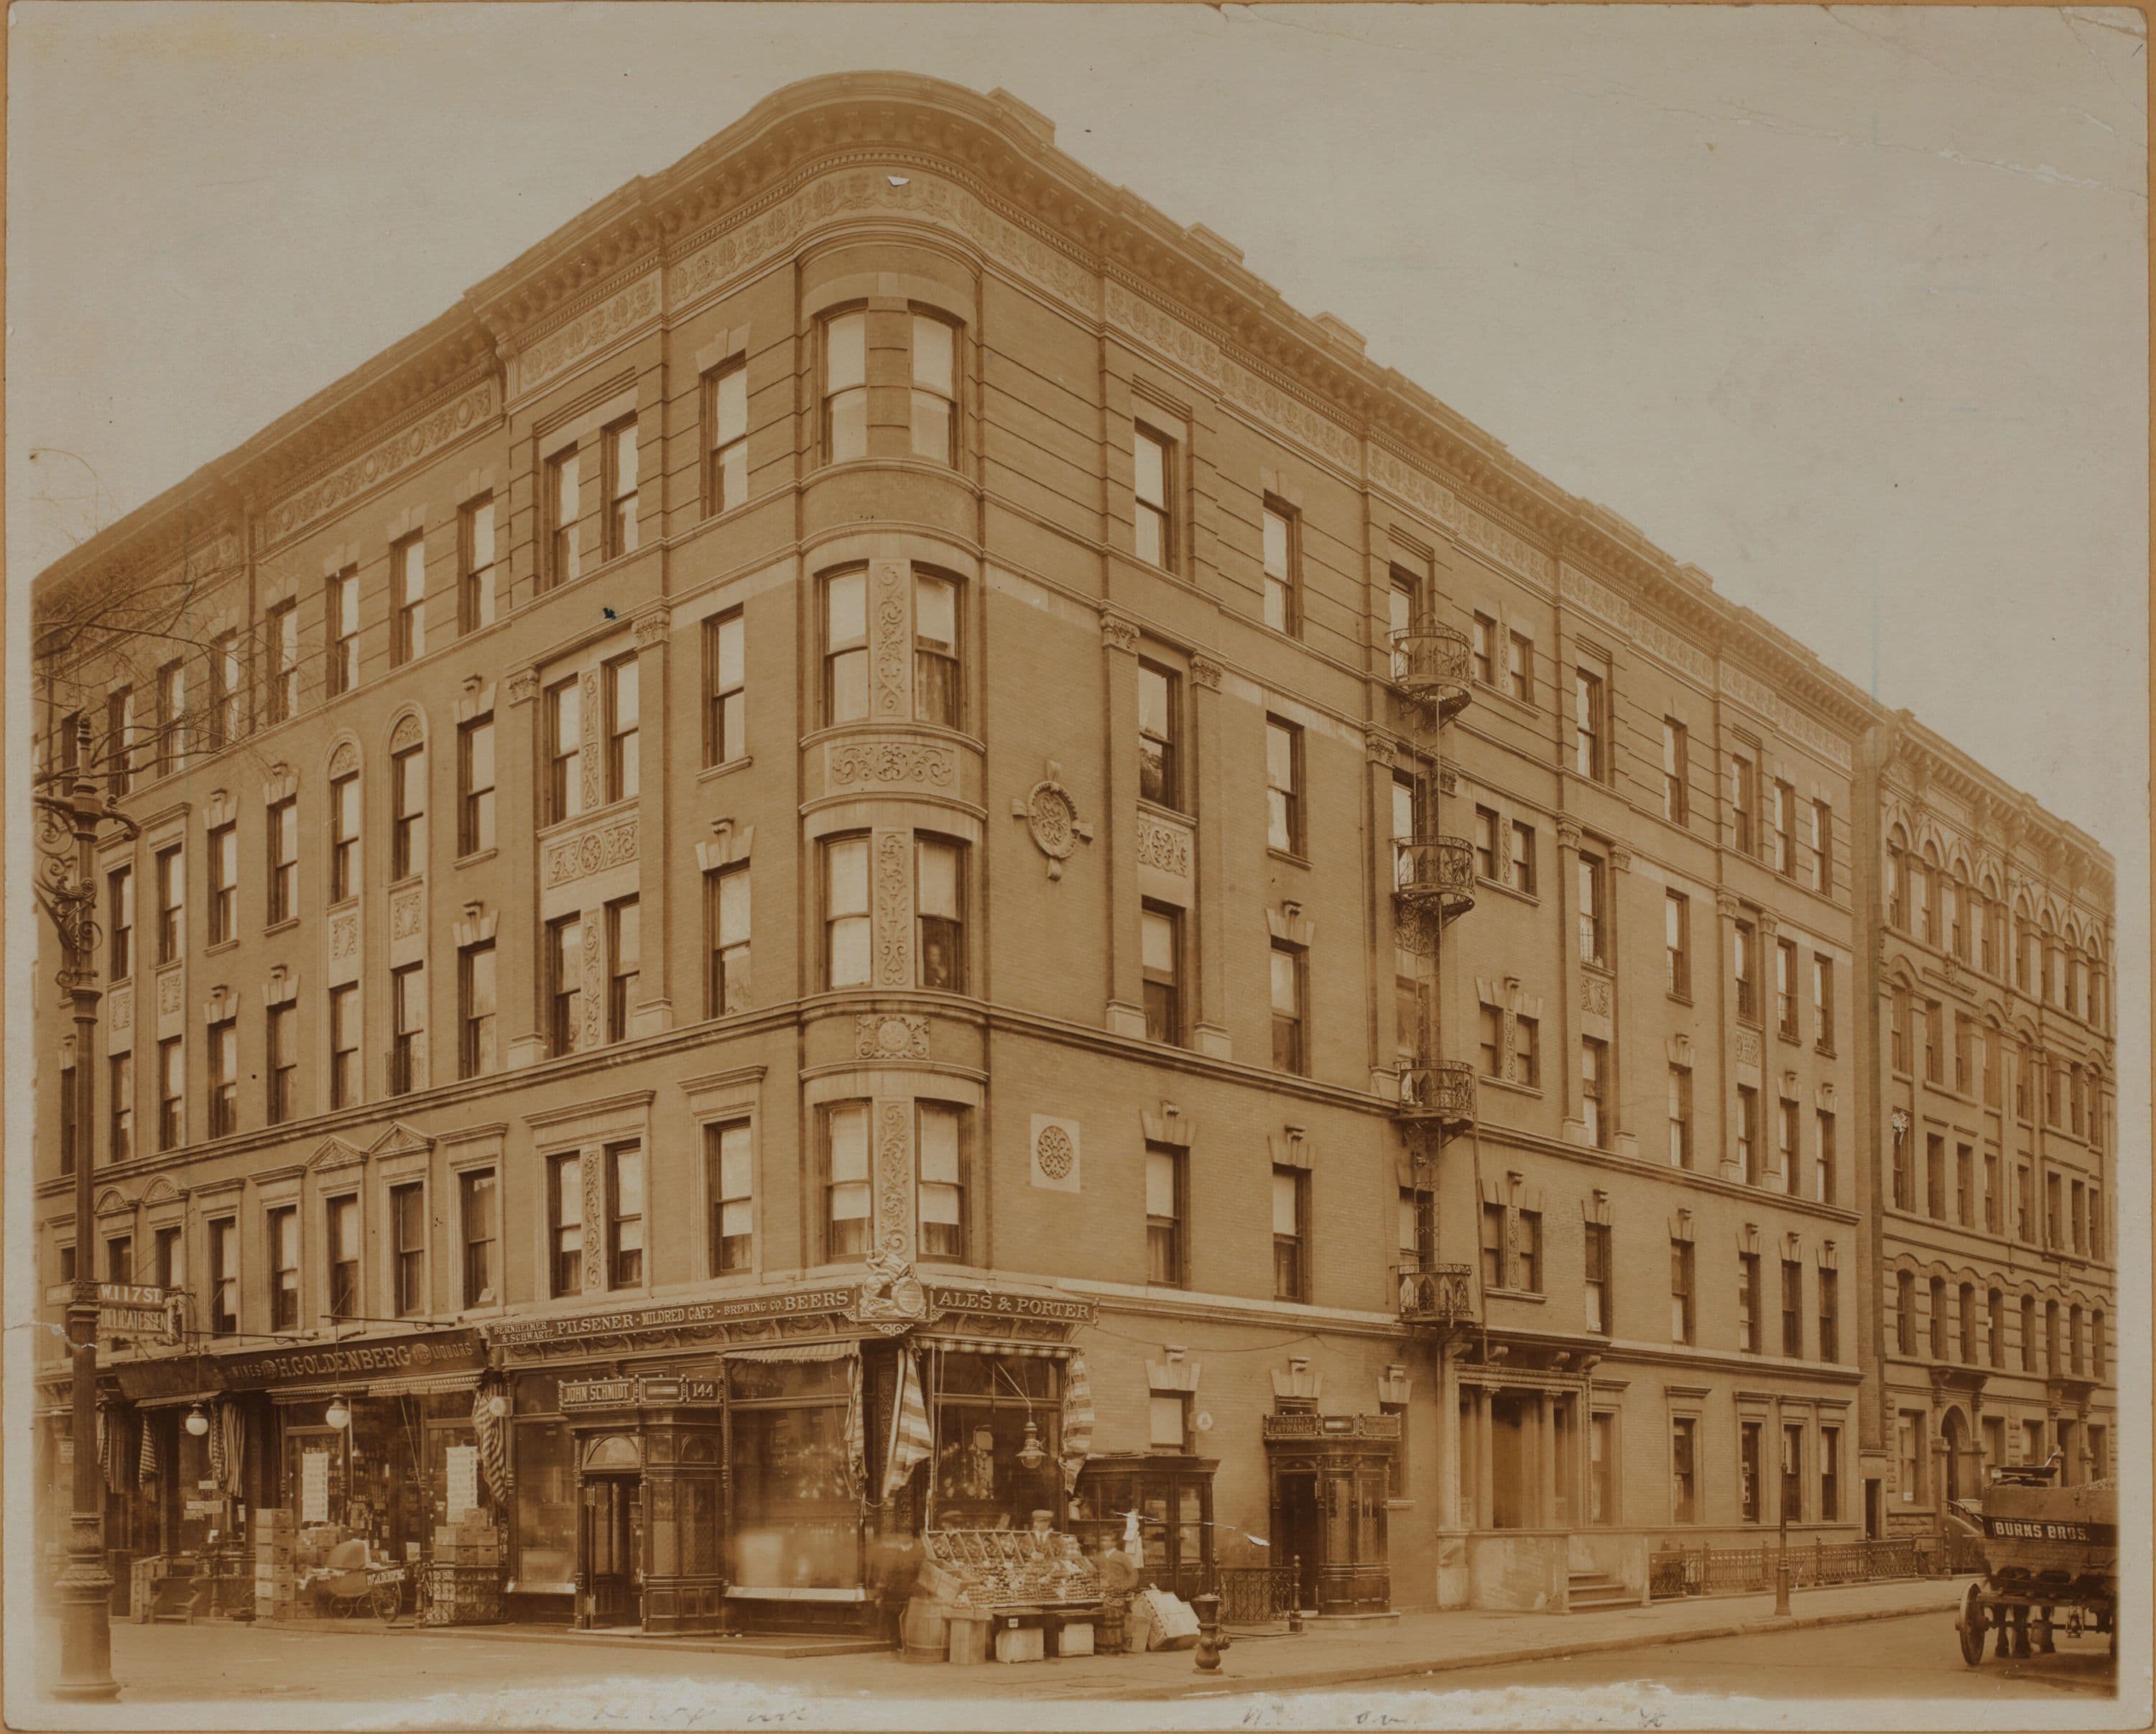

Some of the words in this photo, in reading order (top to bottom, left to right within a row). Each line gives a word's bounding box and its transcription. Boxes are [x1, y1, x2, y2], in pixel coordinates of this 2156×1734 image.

[556, 1314, 634, 1335] PILSENER
[641, 1309, 685, 1325] MILDRED
[688, 1305, 714, 1321] CAFE
[724, 1301, 767, 1316] BREWING
[770, 1300, 783, 1311] CO.
[784, 1291, 849, 1311] BEERS
[939, 1292, 993, 1310] ALES
[997, 1296, 1012, 1311] &
[1017, 1299, 1090, 1319] PORTER
[101, 1309, 167, 1330] DELICATESSEN
[494, 1322, 547, 1334] BERNHEIMER
[502, 1334, 508, 1343] &
[510, 1329, 554, 1343] SCHWARTZ
[430, 1342, 473, 1361] LIQUORS
[565, 1386, 588, 1401] JOHN
[590, 1383, 629, 1401] SCHMIDT
[693, 1383, 714, 1398] 144
[1270, 1424, 1314, 1434] ENTRANCE
[1995, 1522, 2042, 1538] BURNS
[2047, 1526, 2090, 1541] BROS.
